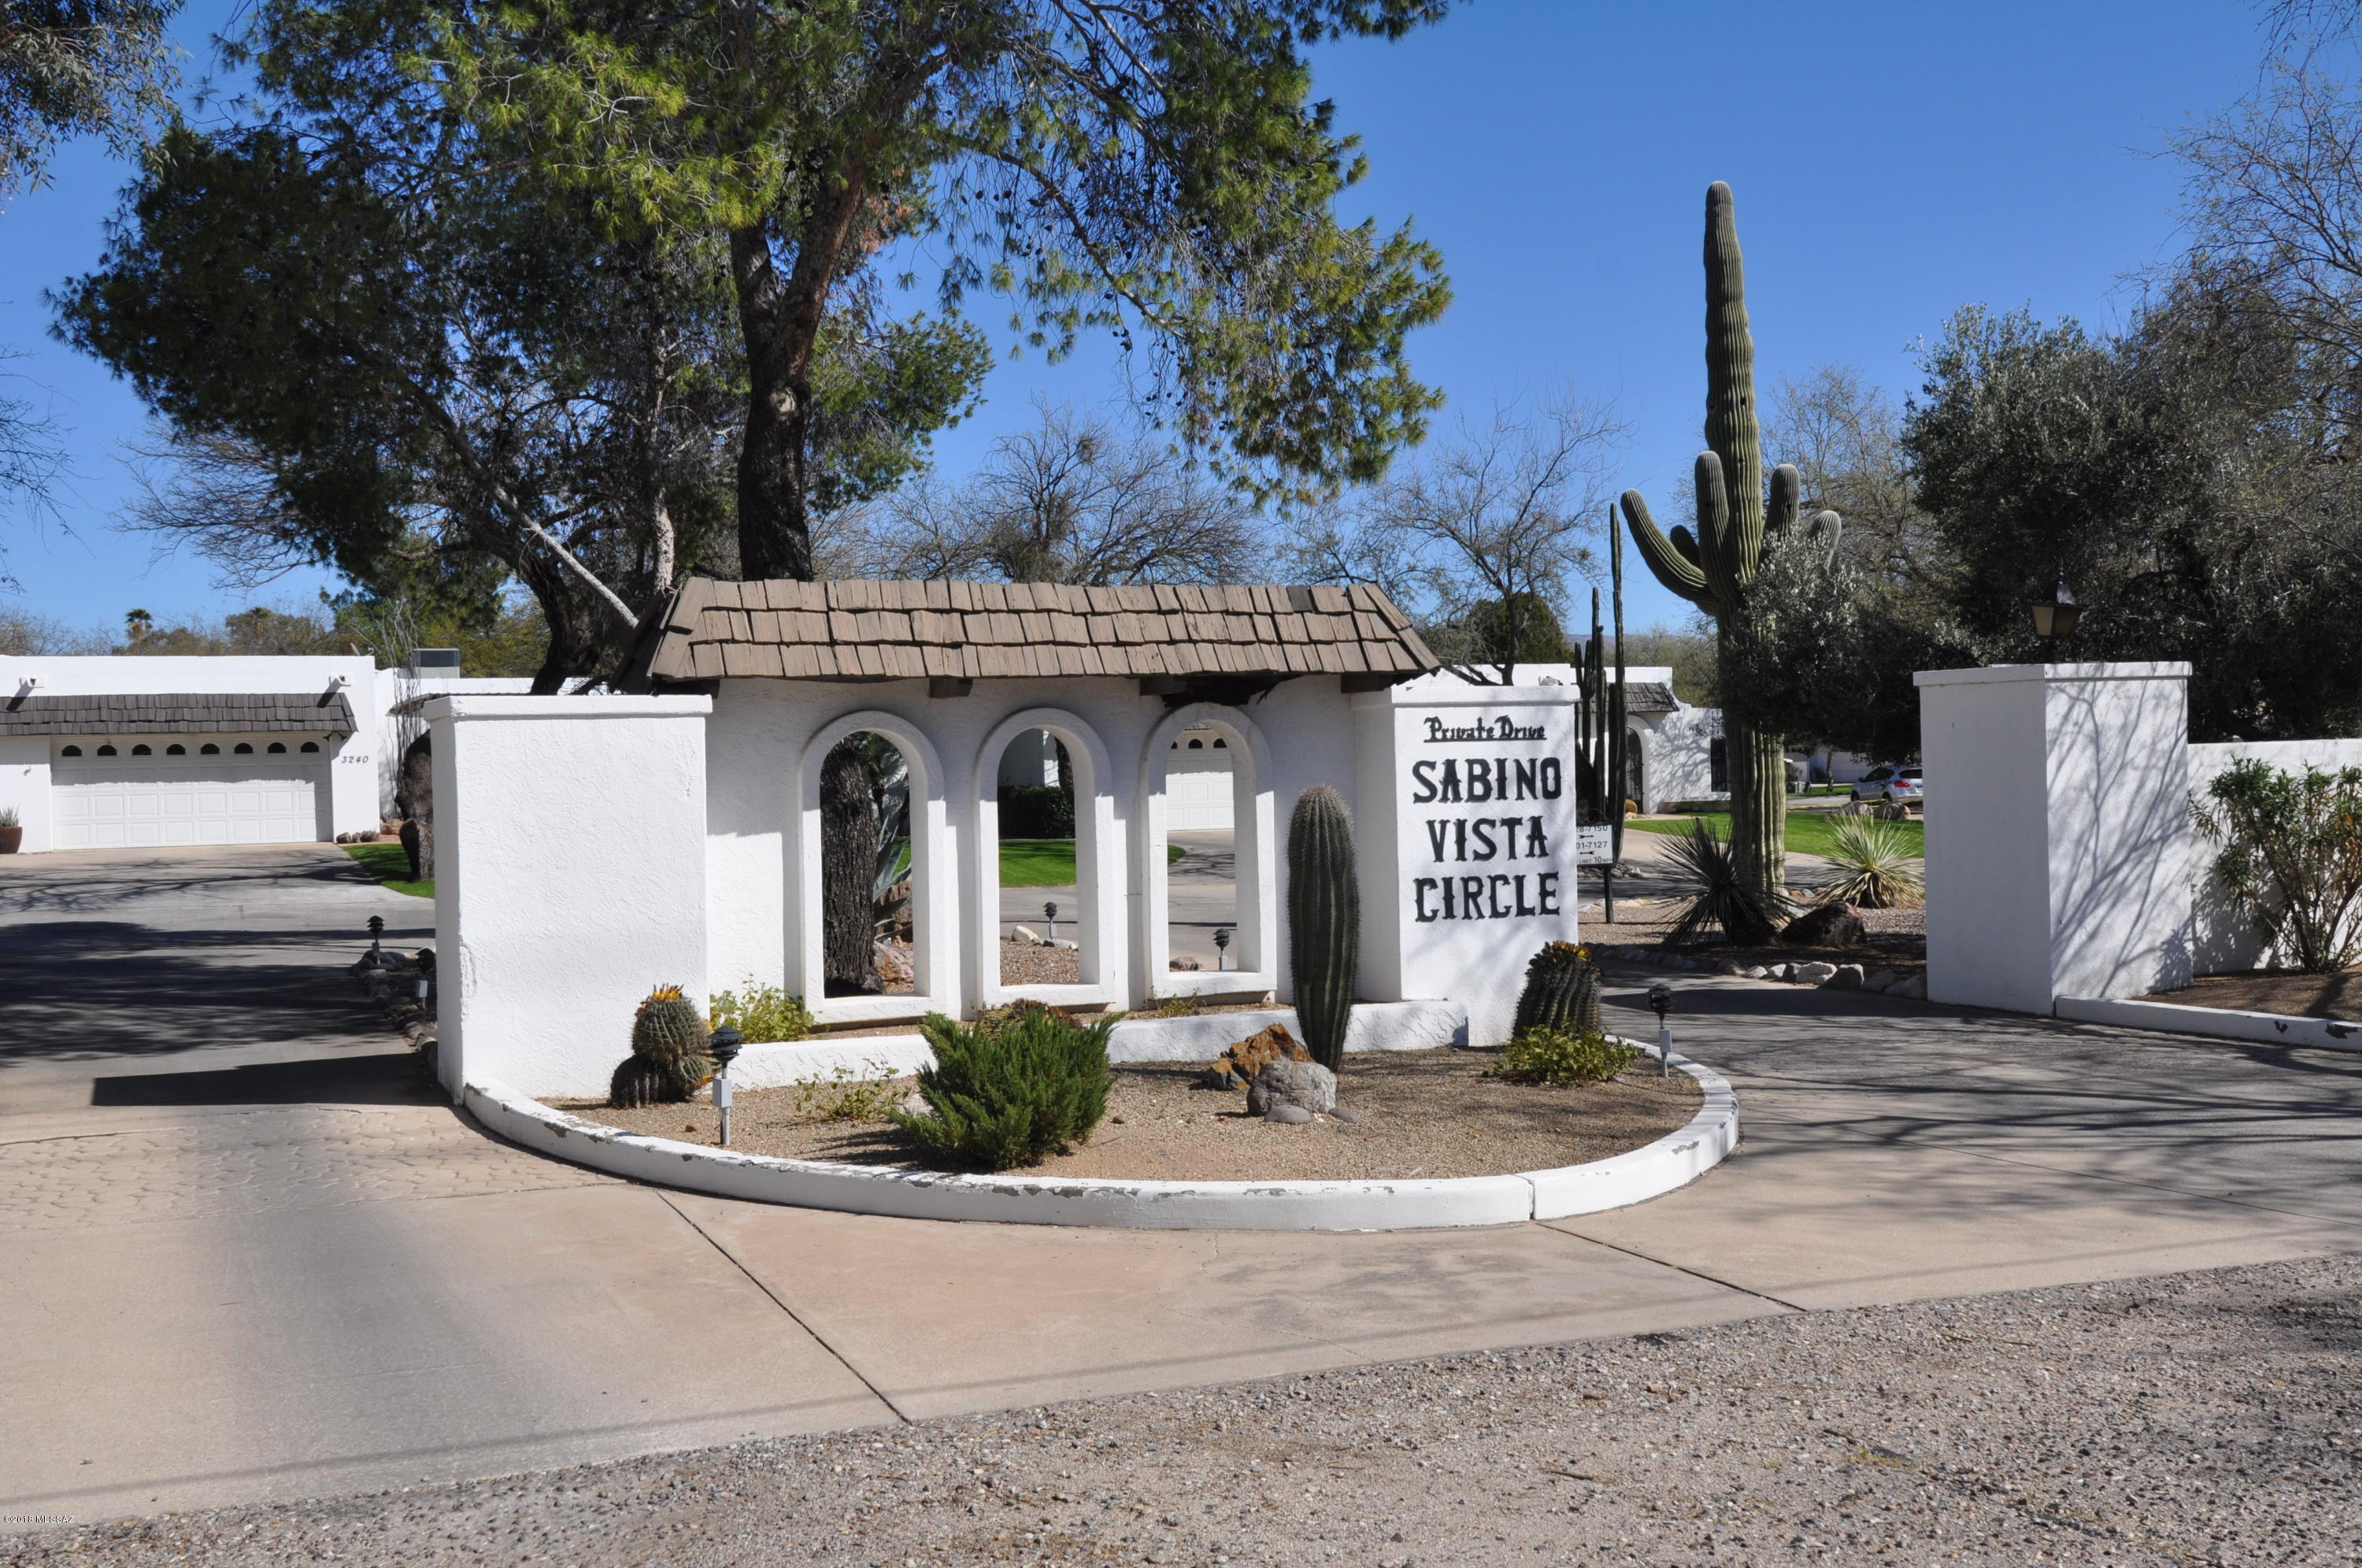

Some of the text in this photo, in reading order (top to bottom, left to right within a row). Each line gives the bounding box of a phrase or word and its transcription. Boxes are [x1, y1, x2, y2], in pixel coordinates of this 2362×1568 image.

[1423, 714, 1546, 740] Private Drive
[342, 755, 368, 764] 3240
[1412, 757, 1562, 804] SABINO
[1425, 815, 1549, 863] VISTA
[1413, 871, 1560, 923] CIRCLE
